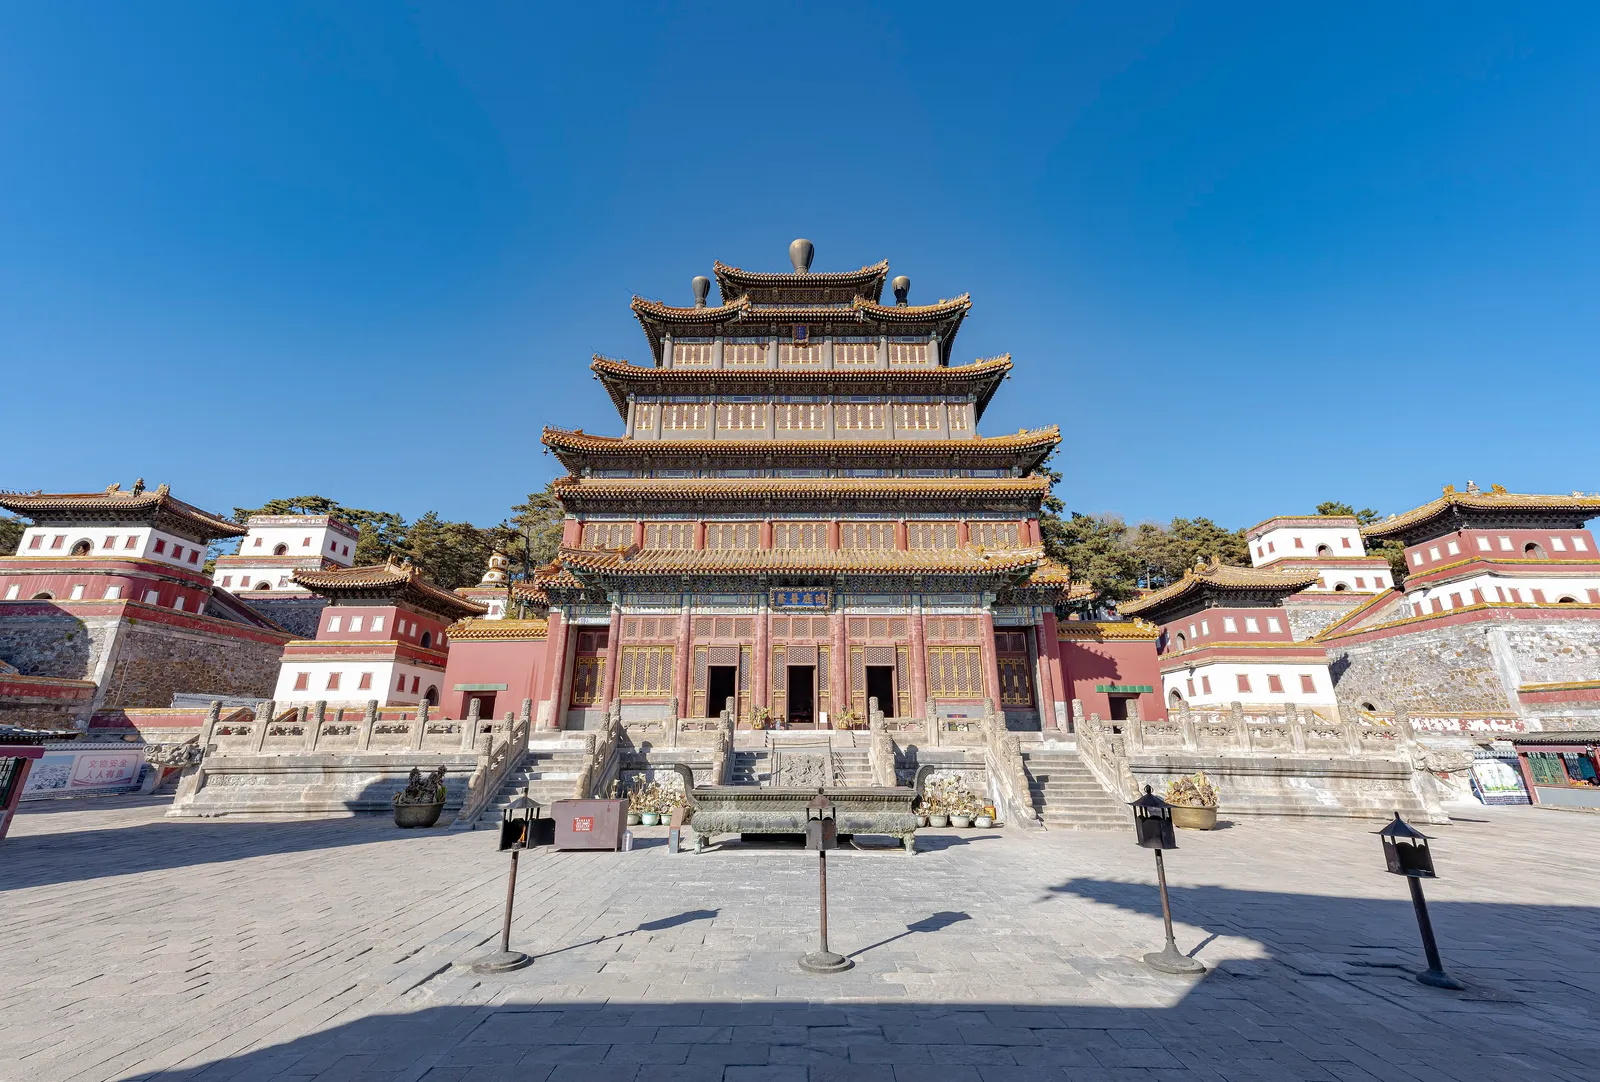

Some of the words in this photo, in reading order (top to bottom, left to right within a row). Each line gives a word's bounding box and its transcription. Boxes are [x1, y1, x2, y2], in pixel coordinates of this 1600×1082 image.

[88, 759, 127, 768] 文物安全
[84, 769, 124, 779] 人人有责
